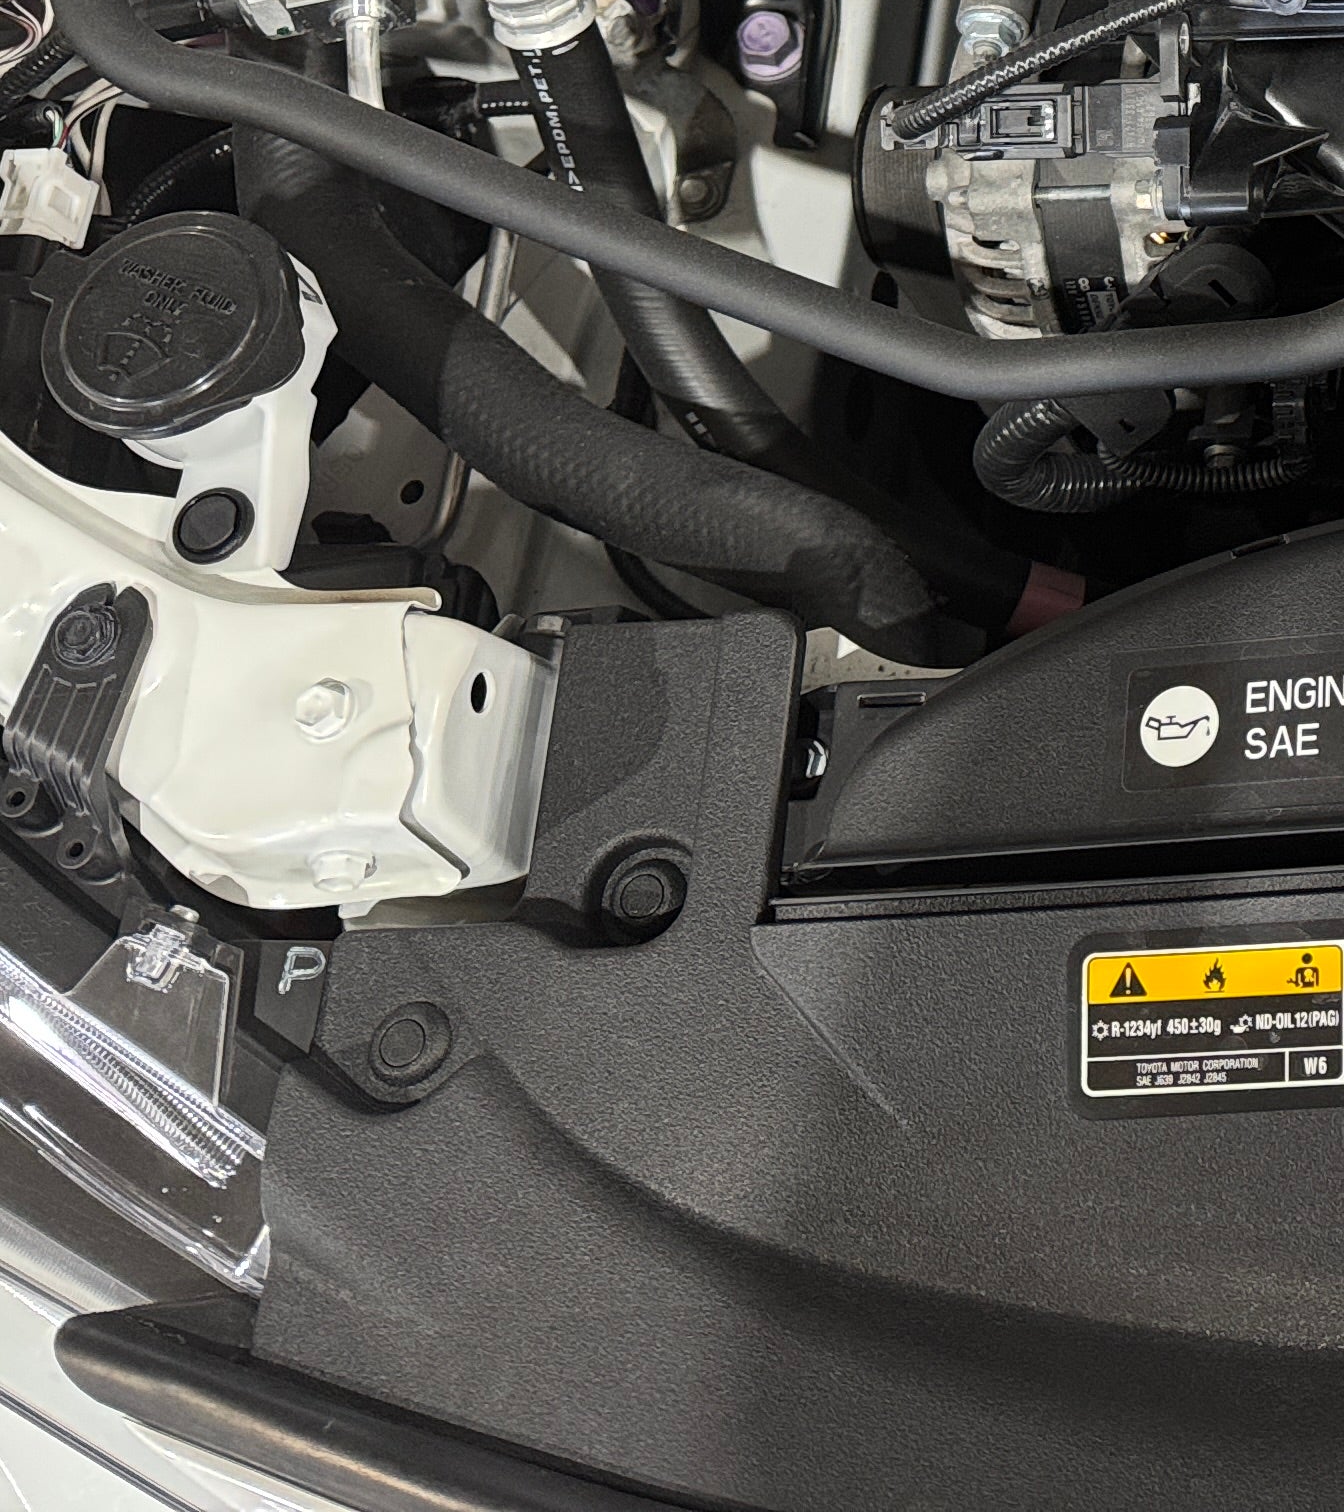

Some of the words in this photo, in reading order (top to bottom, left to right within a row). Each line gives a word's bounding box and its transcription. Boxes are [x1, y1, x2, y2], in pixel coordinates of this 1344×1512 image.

[1244, 726, 1320, 761] SAE
[1110, 1019, 1162, 1040] R-1234yf
[1166, 1017, 1221, 1037] 450±30g
[1255, 1010, 1339, 1031] ND-OIL12(PAG)
[1136, 1062, 1168, 1073] TOYOTA
[1170, 1061, 1200, 1071] MOTOR
[1202, 1058, 1259, 1070] CORPORATION
[1304, 1056, 1328, 1076] W6
[1136, 1075, 1151, 1086] SAE
